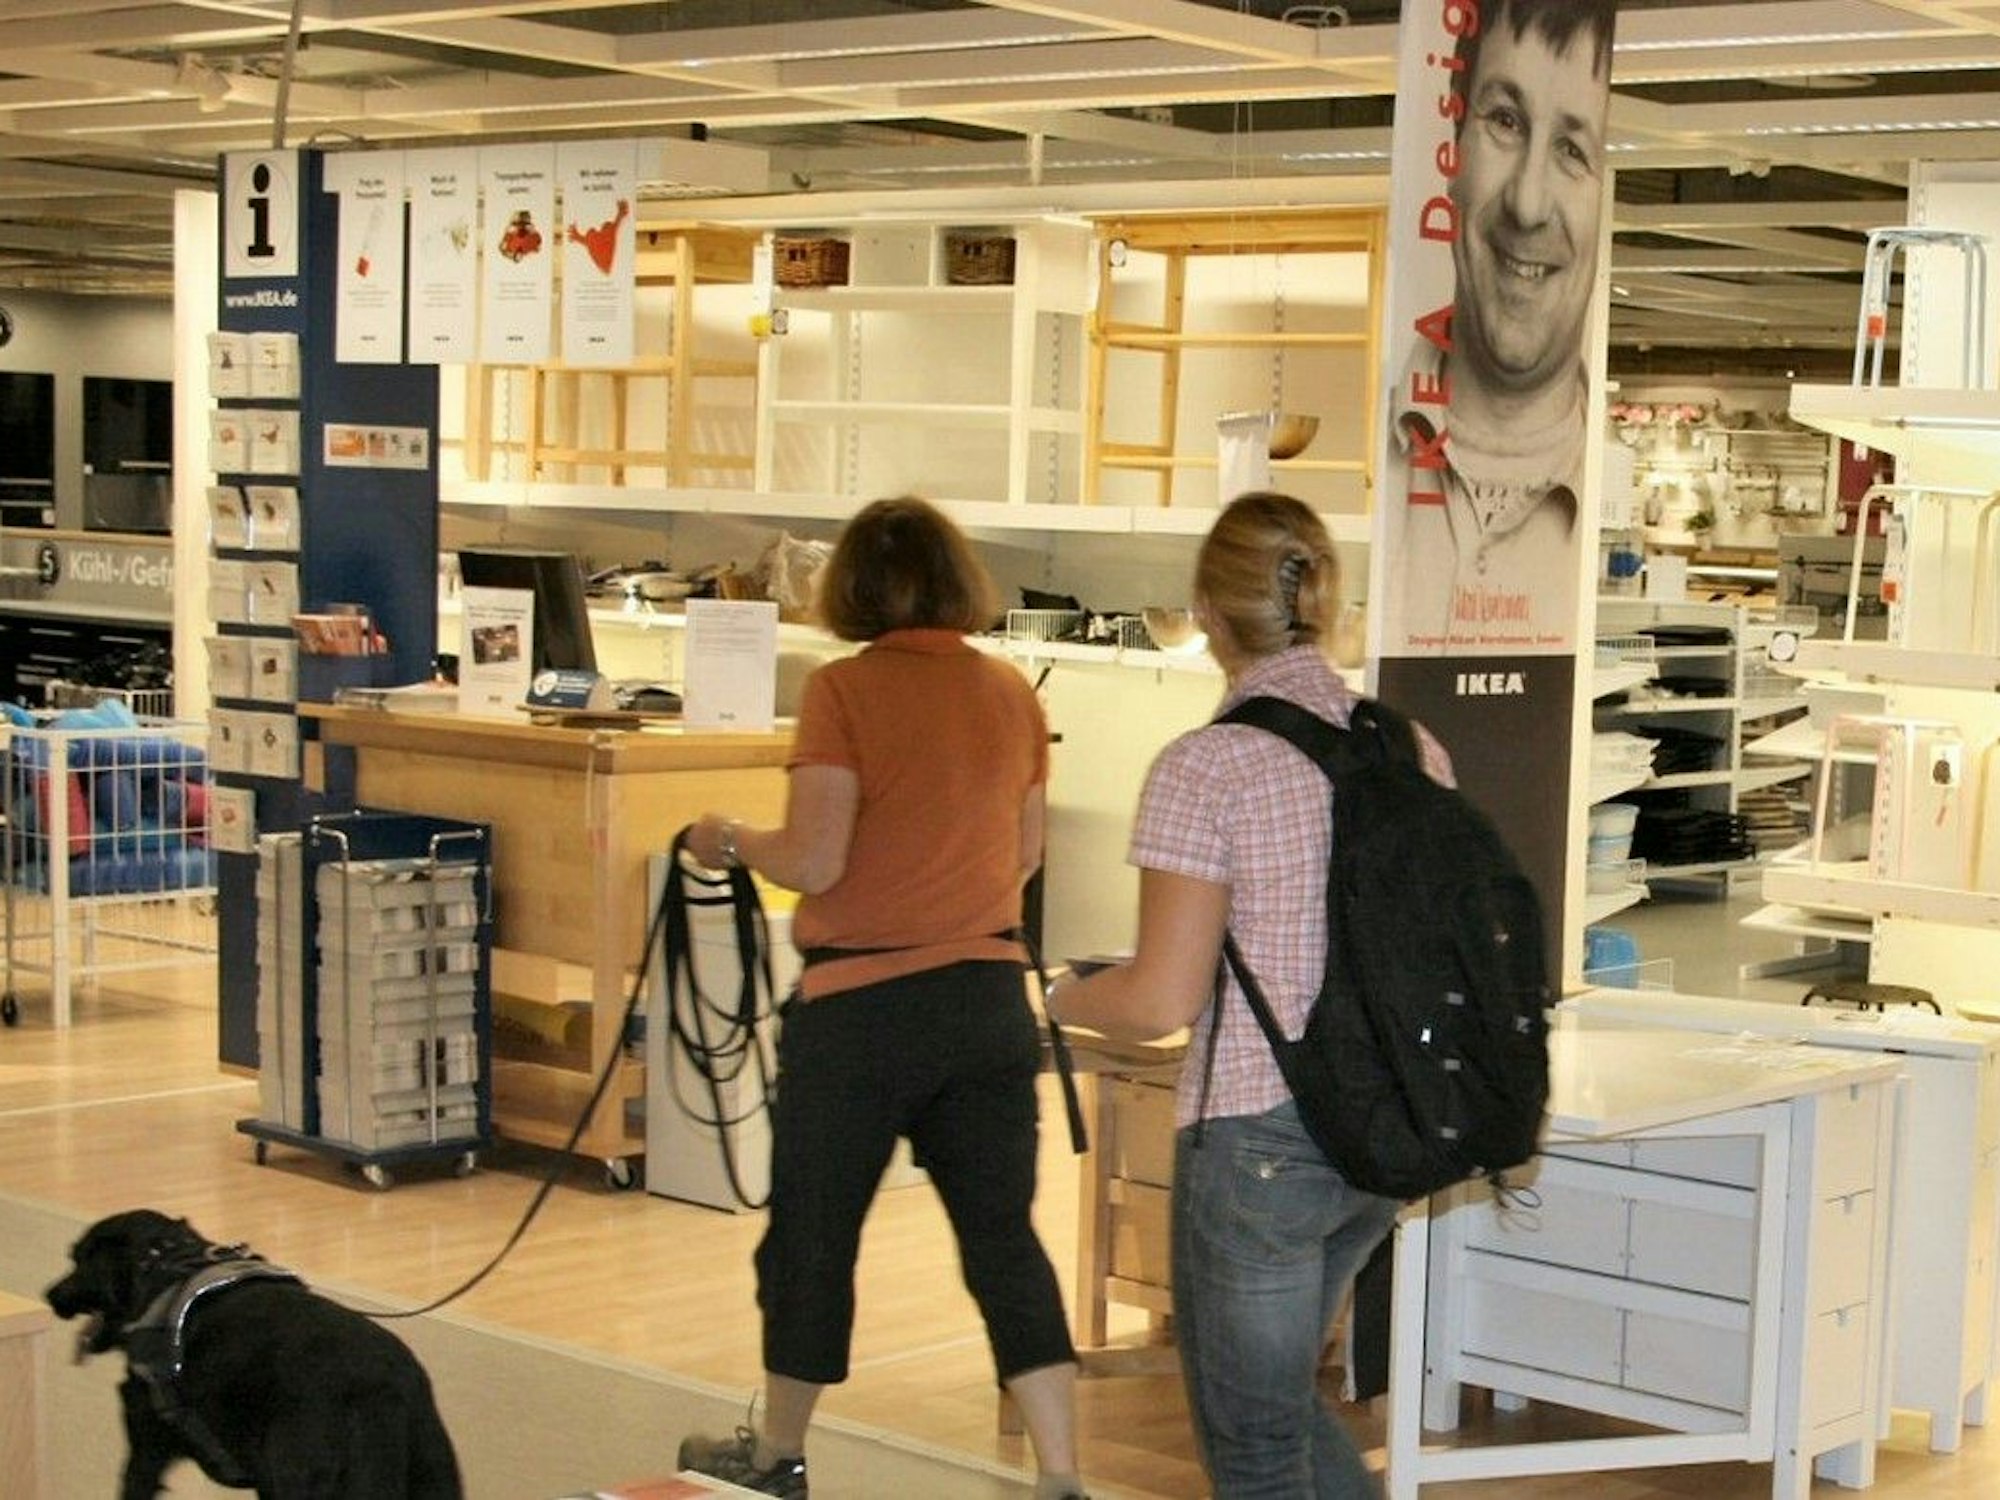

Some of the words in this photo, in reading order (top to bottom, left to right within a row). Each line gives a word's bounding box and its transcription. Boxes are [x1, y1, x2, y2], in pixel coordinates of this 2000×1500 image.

[248, 163, 275, 257] i
[1407, 303, 1457, 506] IKEA
[1455, 671, 1525, 695] IKEA
